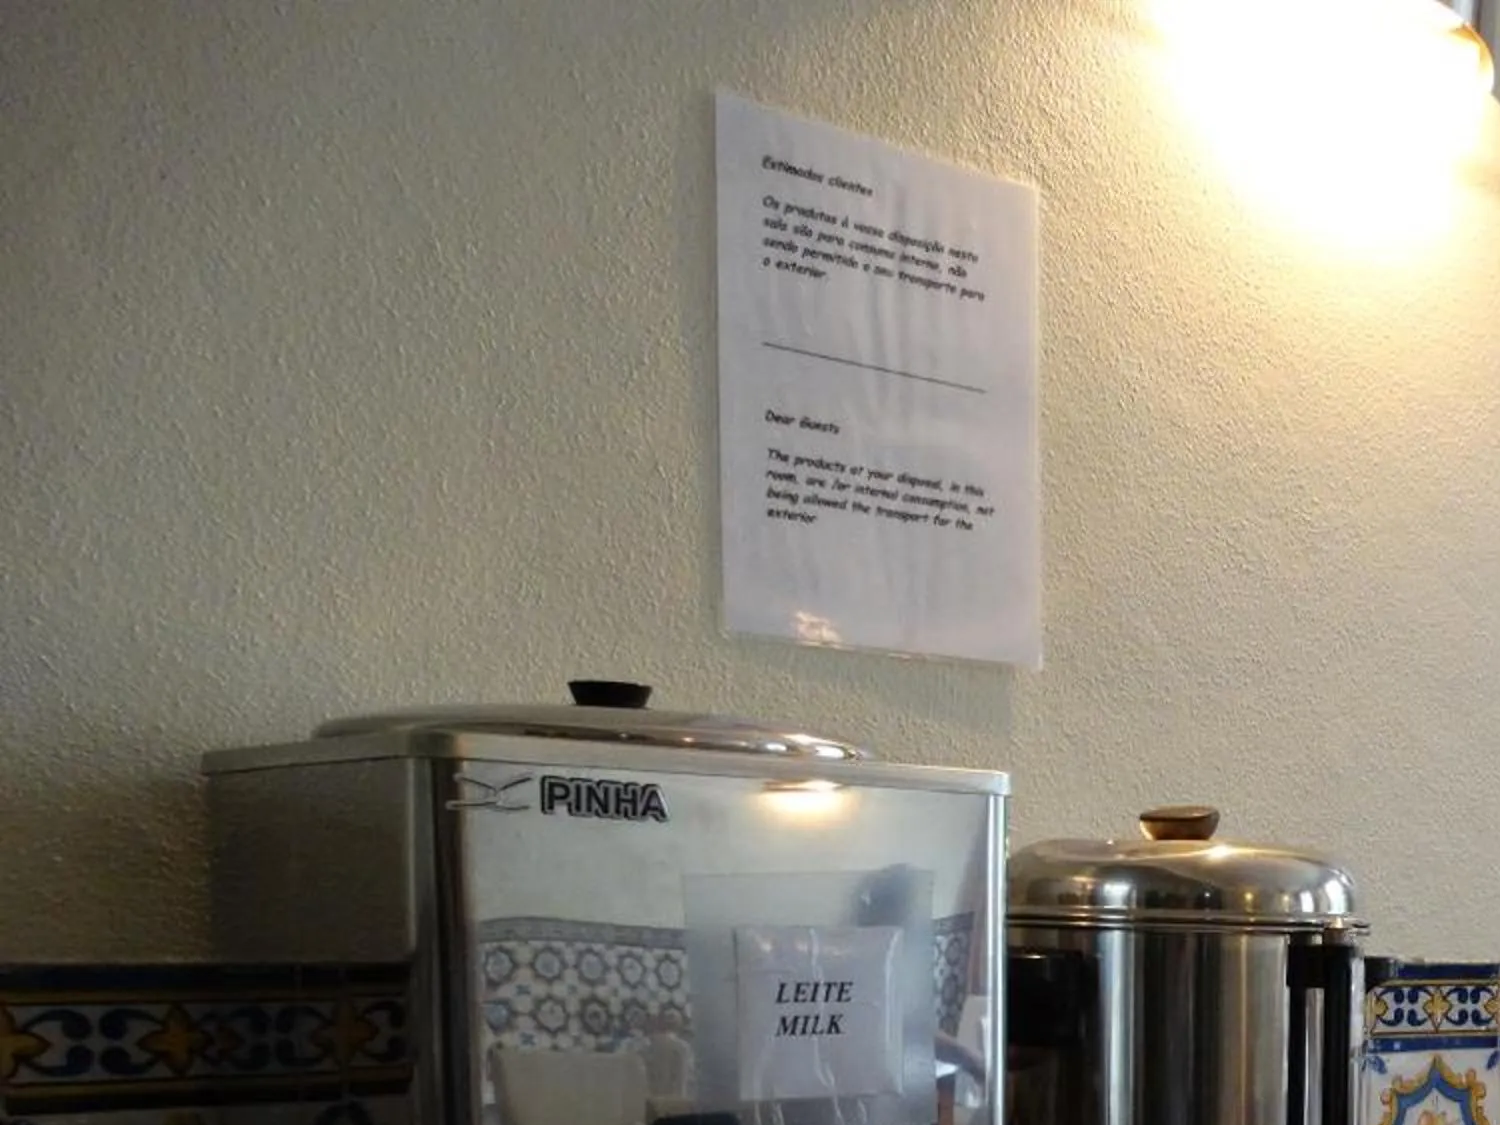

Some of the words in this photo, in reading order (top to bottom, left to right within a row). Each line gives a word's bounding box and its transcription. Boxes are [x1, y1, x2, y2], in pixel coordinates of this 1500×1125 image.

[765, 409, 796, 426] Dear
[799, 415, 840, 435] Guests
[767, 447, 789, 463] The
[793, 456, 846, 474] products
[867, 470, 894, 482] your
[851, 501, 871, 514] the
[876, 506, 929, 524] transport
[933, 514, 951, 527] for
[955, 517, 974, 531] the
[541, 775, 669, 823] PINHA
[775, 981, 854, 1004] LEITE
[775, 1013, 846, 1037] MILK
